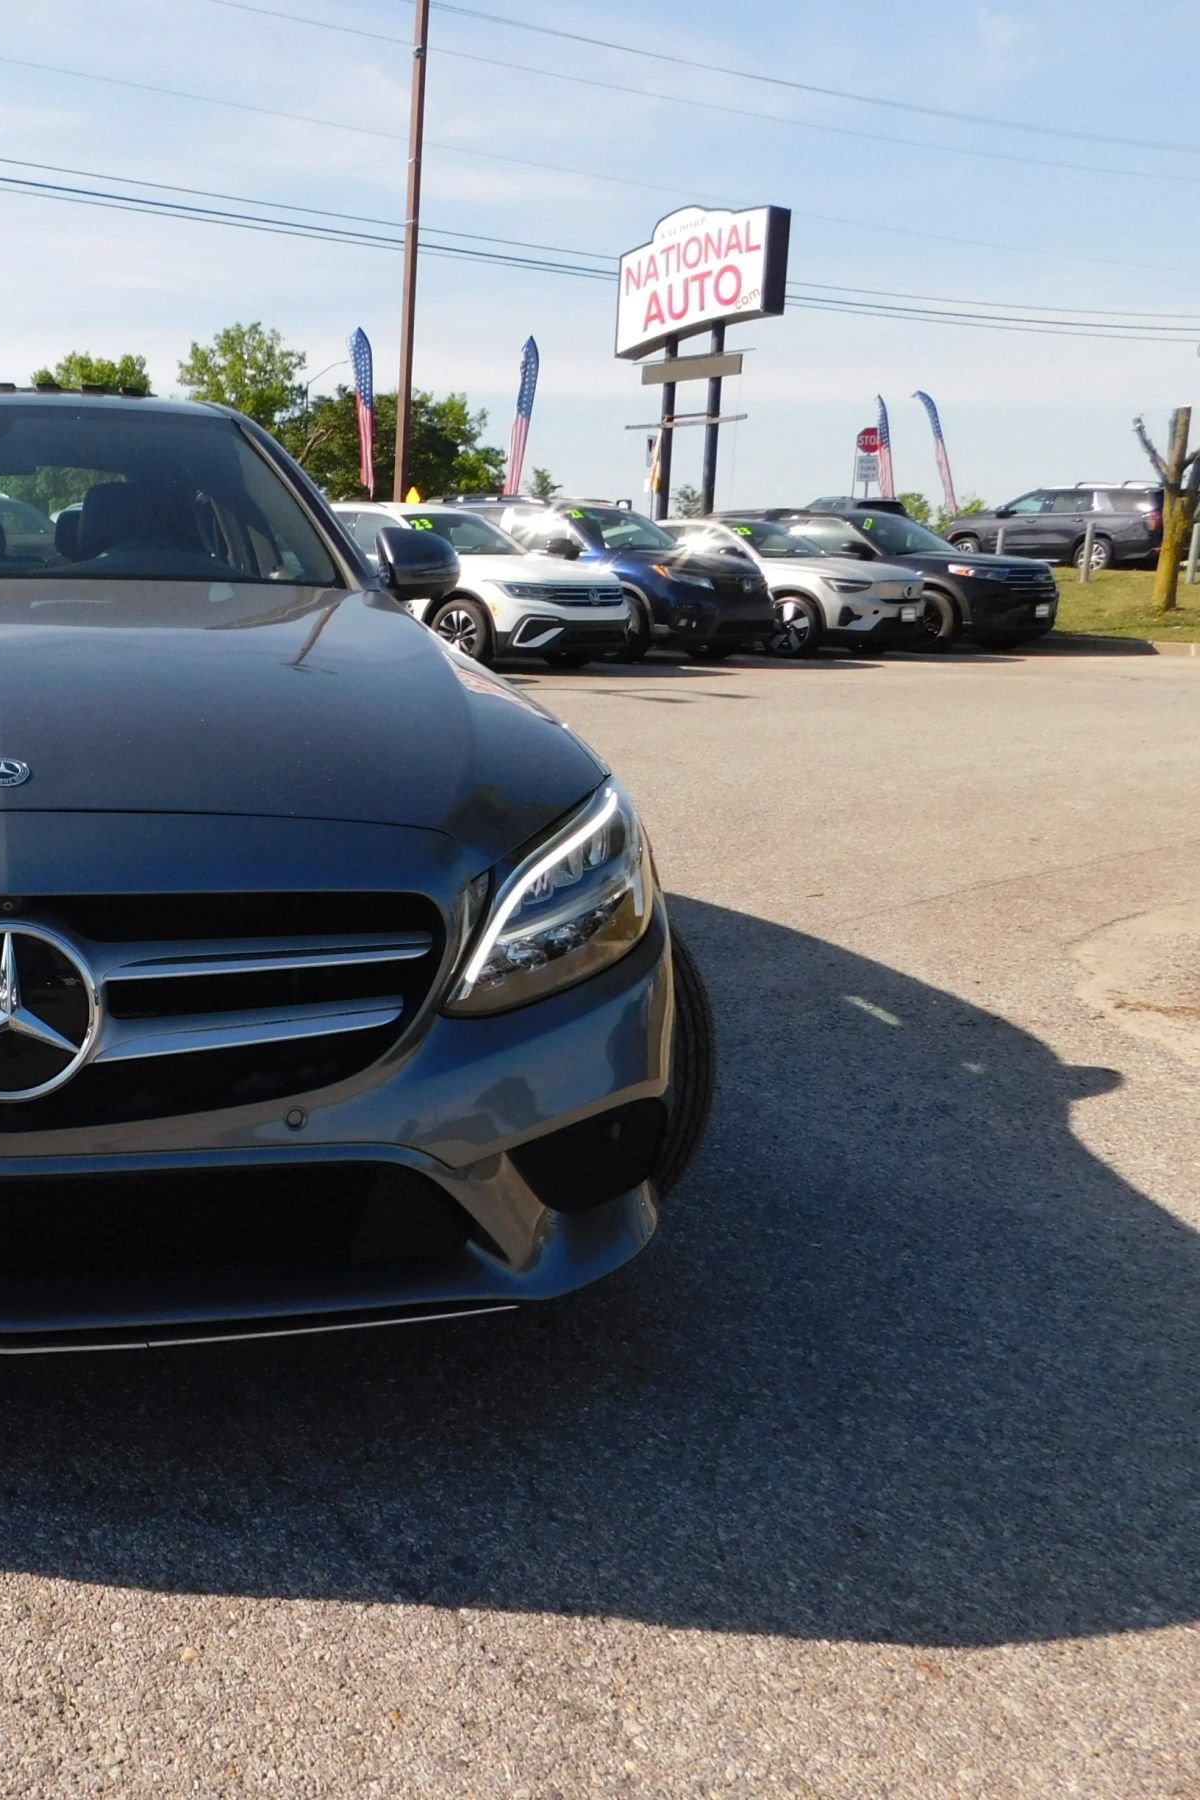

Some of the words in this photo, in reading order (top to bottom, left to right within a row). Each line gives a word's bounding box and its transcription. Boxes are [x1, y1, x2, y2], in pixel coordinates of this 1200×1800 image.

[625, 220, 761, 296] NATIONAL
[642, 264, 742, 332] AUTO
[858, 435, 880, 446] STO
[409, 518, 433, 530] 23
